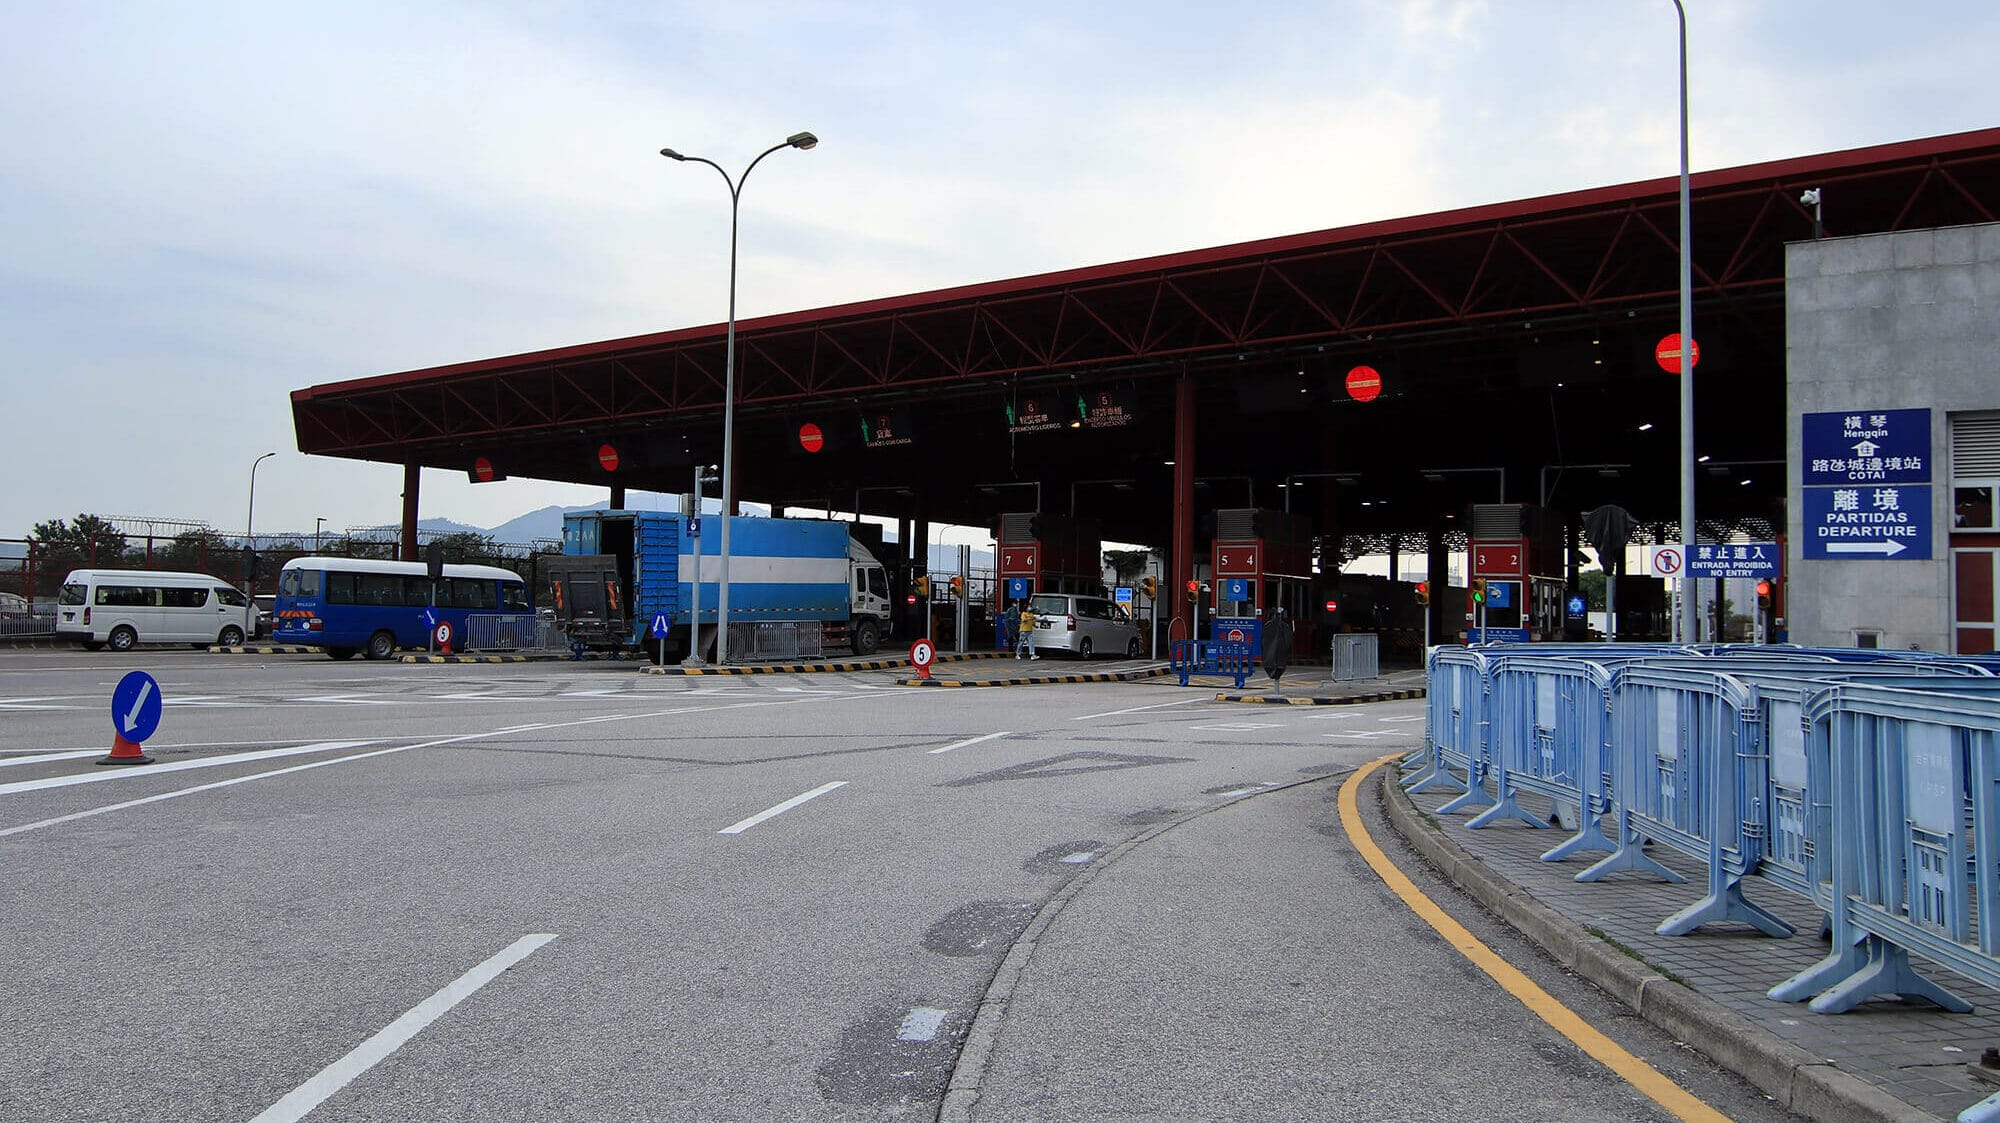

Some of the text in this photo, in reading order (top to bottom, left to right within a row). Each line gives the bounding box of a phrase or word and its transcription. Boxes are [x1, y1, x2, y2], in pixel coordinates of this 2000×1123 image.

[1102, 396, 1108, 405] 5
[1028, 404, 1034, 412] 6
[1844, 429, 1888, 439] Hengqin
[1848, 470, 1886, 480] COTAI
[1833, 488, 1900, 511] 離境
[1827, 512, 1908, 524] PARTIDAS
[1818, 526, 1916, 537] DEPARTURE
[1698, 547, 1765, 560] 禁止進入
[1005, 555, 1033, 566] 7 6
[1221, 554, 1254, 566] 5 4
[1479, 555, 1518, 565] 3 2
[440, 628, 446, 640] 5
[919, 647, 924, 661] 5
